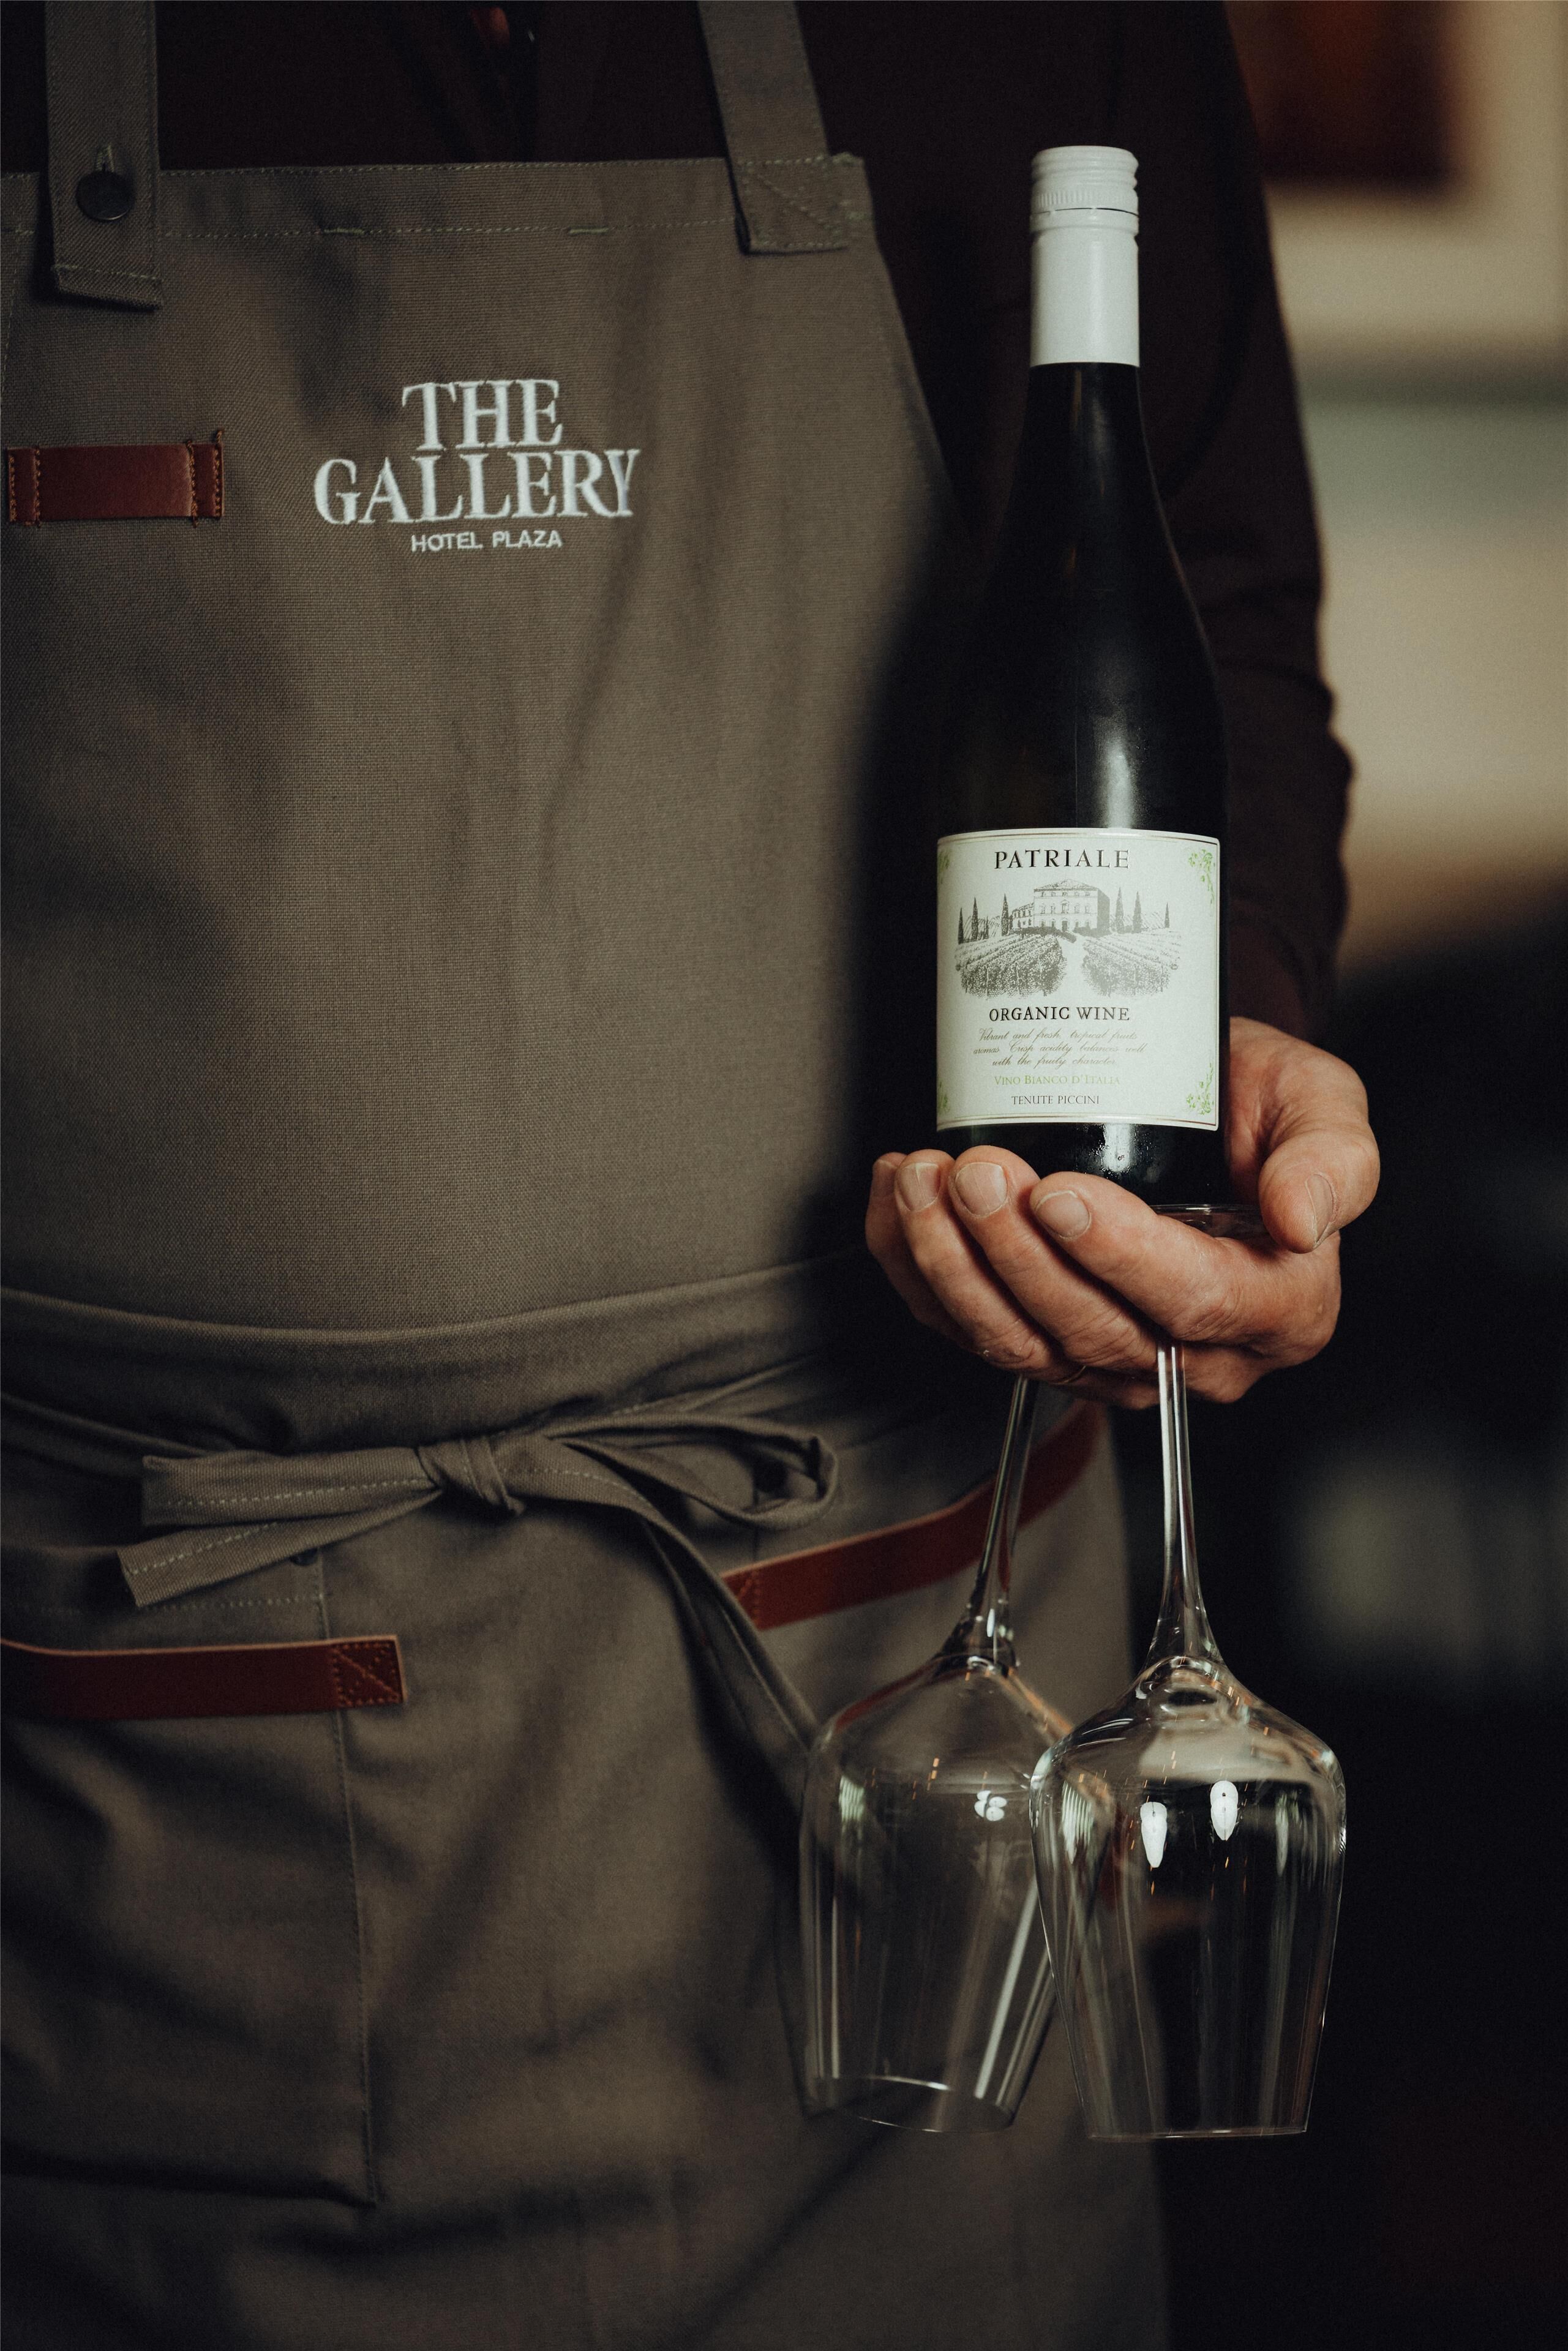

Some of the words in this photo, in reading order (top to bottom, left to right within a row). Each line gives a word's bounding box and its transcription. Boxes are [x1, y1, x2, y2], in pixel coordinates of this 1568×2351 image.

[402, 378, 563, 451] THE
[313, 449, 641, 525] GALLERY
[411, 531, 484, 552] HOTEL
[492, 530, 563, 548] PLAZA
[994, 849, 1130, 869] PATRIALE
[989, 1007, 1070, 1022] ORGANIC
[1076, 1007, 1130, 1021] WINE
[980, 1027, 1010, 1041] Vibrant
[1012, 1028, 1035, 1039] and
[1070, 1029, 1110, 1043] tropical
[1107, 1028, 1138, 1043] fruits
[1008, 1039, 1035, 1056] Crisp
[1040, 1040, 1073, 1060] acidity
[1079, 1041, 1119, 1052] balances
[1125, 1042, 1148, 1053] well
[992, 1054, 1013, 1067] with
[1016, 1054, 1032, 1065] the
[1033, 1052, 1067, 1070] fruity
[994, 1075, 1021, 1086] VINO
[1024, 1074, 1068, 1085] BIANCO
[1011, 1095, 1054, 1105] TENUTE
[1057, 1095, 1100, 1104] PICCINI
